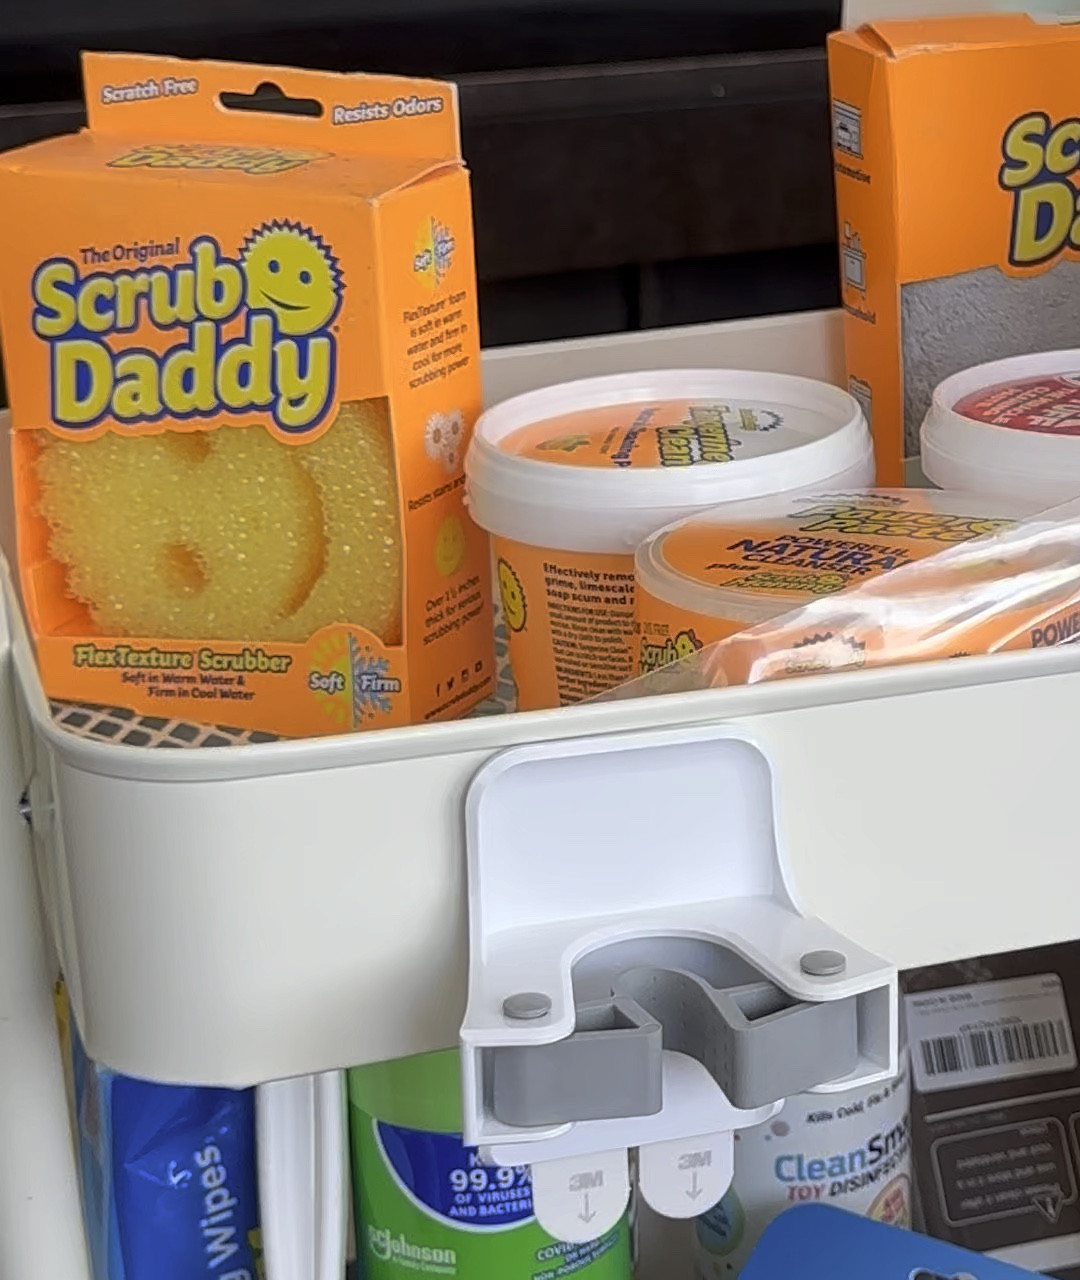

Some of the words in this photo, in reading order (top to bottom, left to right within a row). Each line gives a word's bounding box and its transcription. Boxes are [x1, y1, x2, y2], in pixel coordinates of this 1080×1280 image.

[102, 78, 158, 104] Scratch
[163, 76, 198, 97] Free
[333, 101, 389, 126] Resists
[392, 95, 443, 118] Odors
[80, 248, 111, 265] The
[113, 236, 180, 263] Original
[32, 235, 248, 339] Scrub
[50, 307, 336, 434] Daddy
[655, 423, 698, 468] Clean
[775, 534, 911, 558] POWERFUL
[543, 562, 600, 582] Effectively
[603, 573, 636, 582] remo
[705, 563, 760, 572] plus
[742, 553, 872, 576] CLEANSER
[545, 576, 577, 591] grime,
[546, 588, 570, 602] soap
[572, 592, 602, 604] scum
[604, 596, 627, 606] and
[73, 643, 194, 670] FlexTexture
[198, 647, 292, 673] Scrubber
[121, 671, 146, 686] Soft
[148, 672, 160, 684] in
[161, 672, 197, 685] Warm
[200, 673, 235, 686] Water
[235, 674, 245, 686] &
[308, 672, 345, 695] Soft
[359, 673, 402, 693] Firm
[148, 686, 176, 699] Firm
[178, 687, 190, 699] in
[191, 687, 219, 700] Cool
[220, 688, 256, 702] Water
[678, 1150, 713, 1171] 3M
[569, 1170, 604, 1193] 3M
[787, 1184, 828, 1202] TOY
[194, 1144, 241, 1269] Wipes
[455, 1191, 472, 1205] OF
[477, 1186, 532, 1203] VIRUSES
[450, 1203, 478, 1218] AND
[478, 1199, 533, 1218] BACTERI
